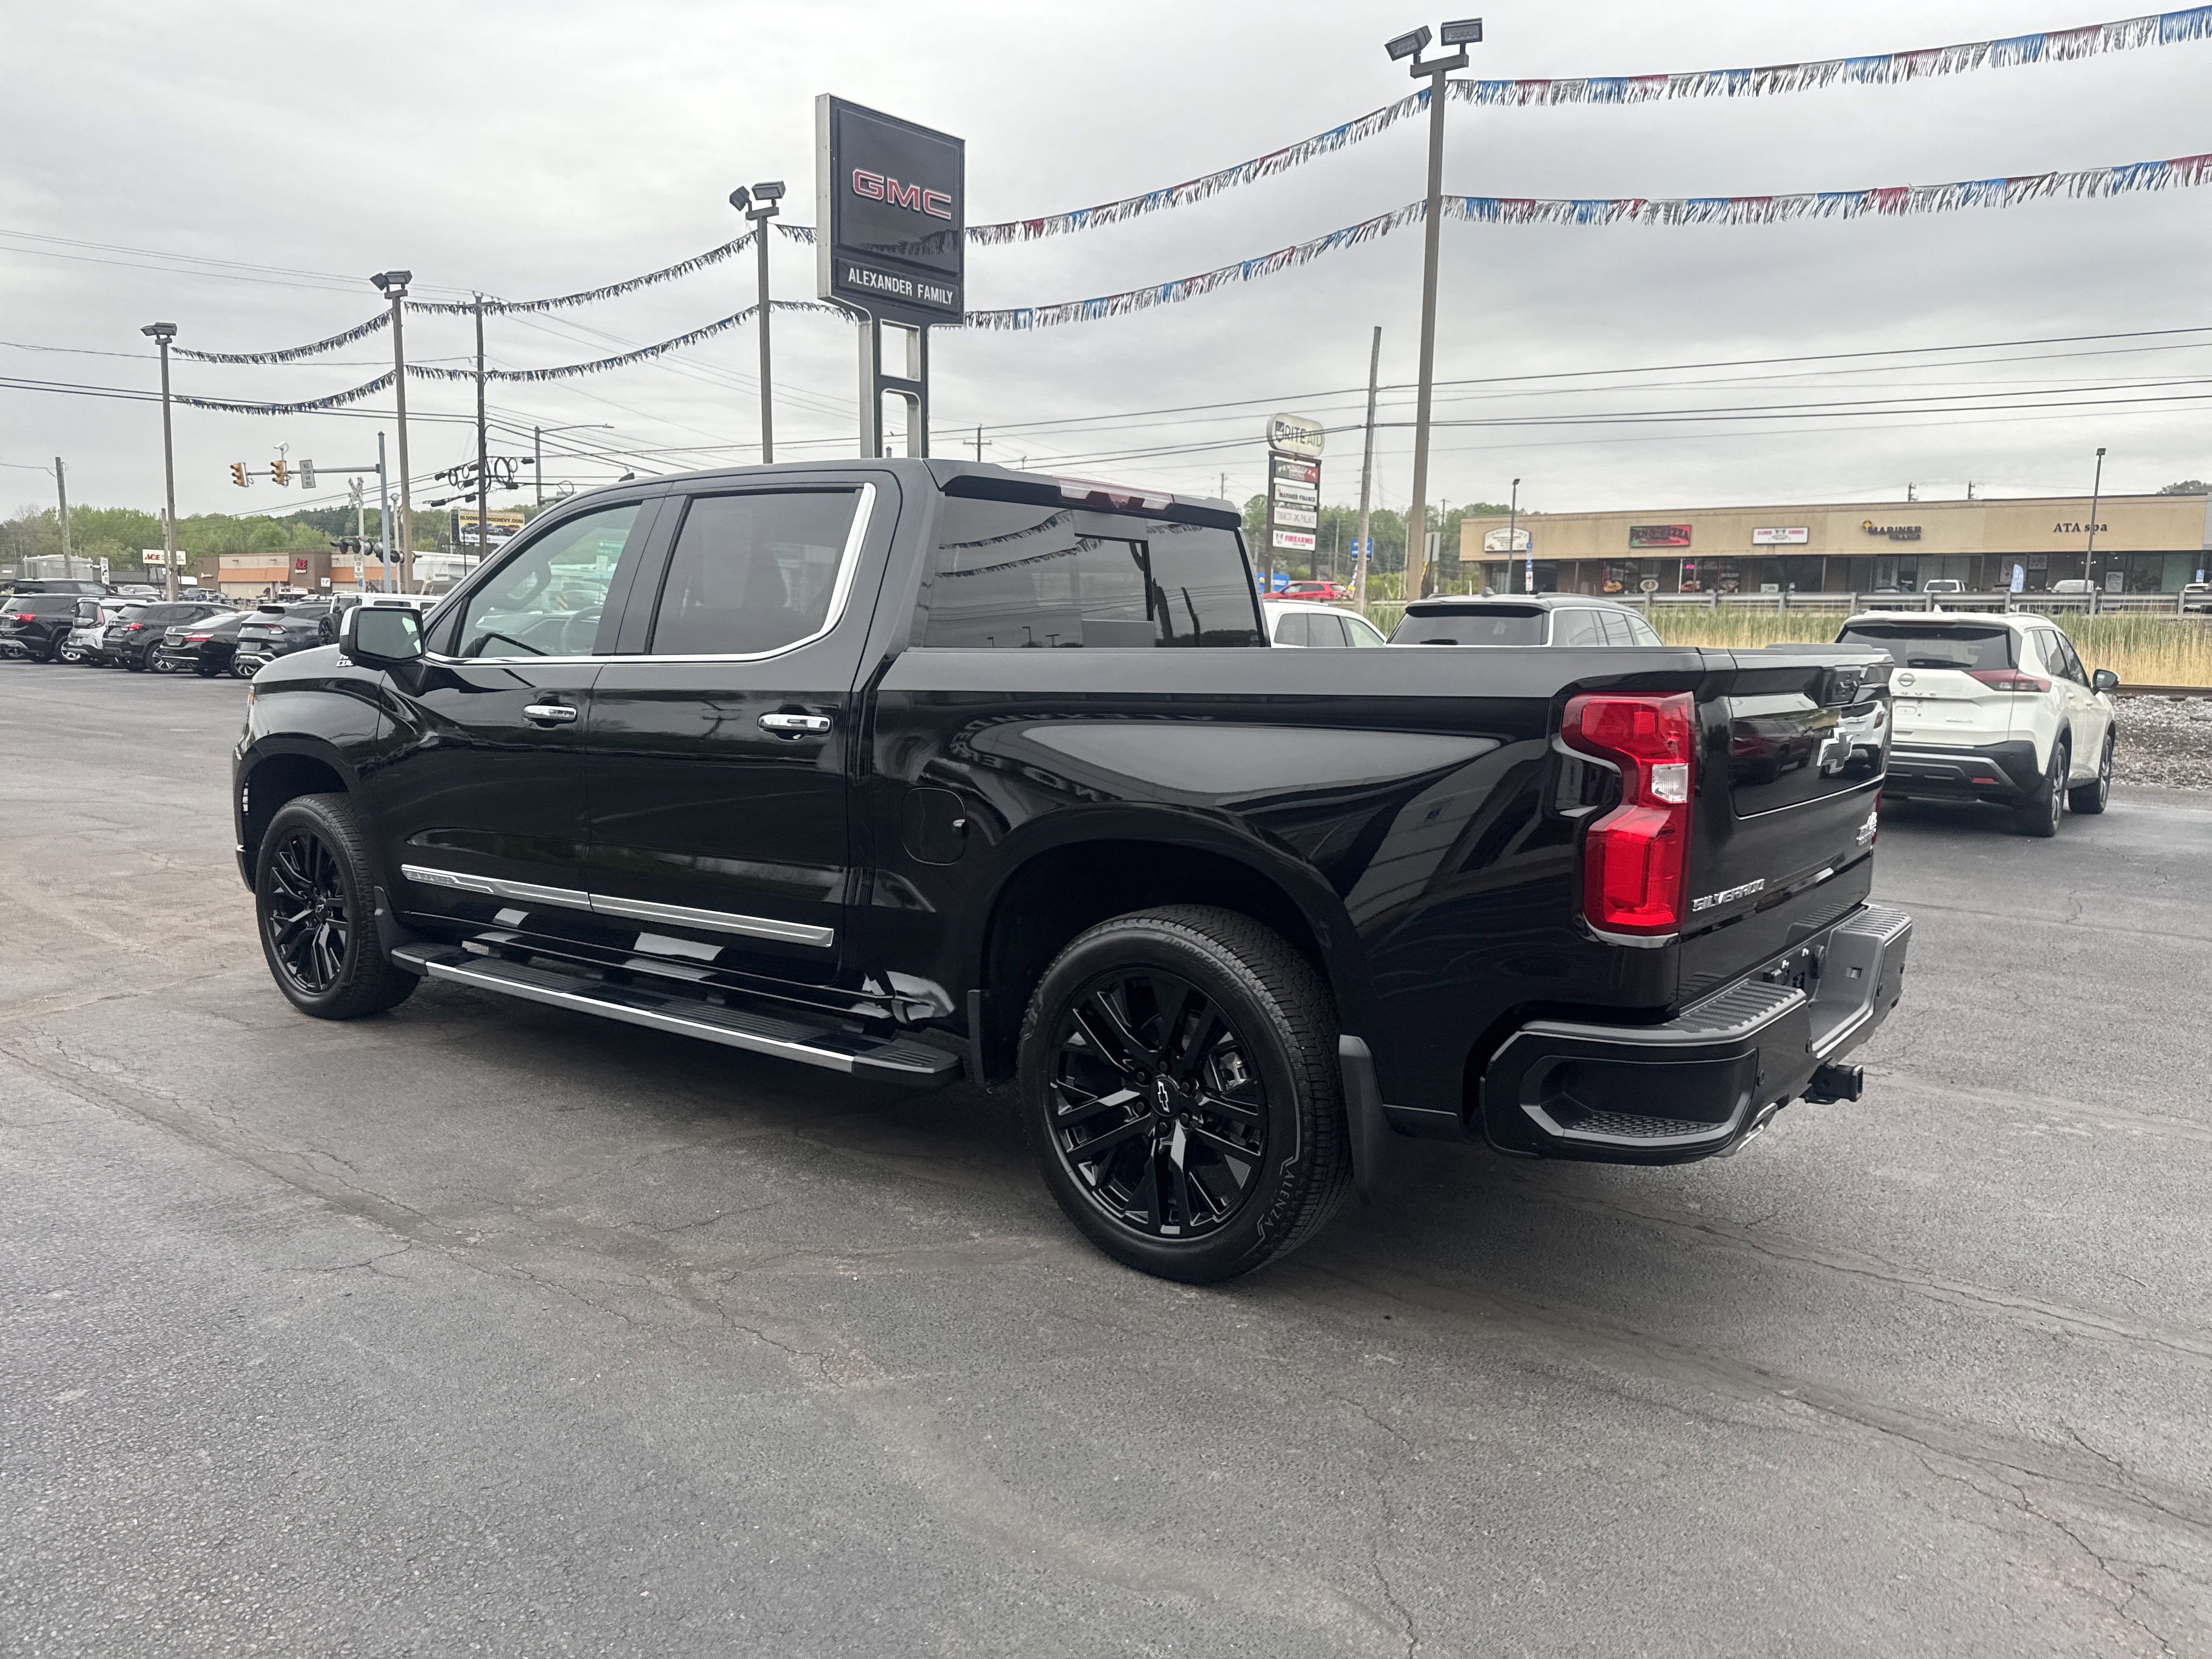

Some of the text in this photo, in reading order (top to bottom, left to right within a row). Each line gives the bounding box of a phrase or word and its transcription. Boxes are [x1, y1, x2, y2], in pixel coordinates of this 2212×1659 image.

[853, 168, 952, 220] GMC
[848, 267, 953, 305] ALEXANDER FAMILY
[460, 515, 523, 524] BLOOMRGCHEVY.COM
[1867, 526, 1921, 535] MARINER
[2053, 522, 2108, 535] ATA spa
[1285, 535, 1313, 545] FIREARMS
[296, 558, 308, 569] ACE
[1692, 878, 1765, 912] SILVERADO
[1264, 1170, 1295, 1227] ALENZA
